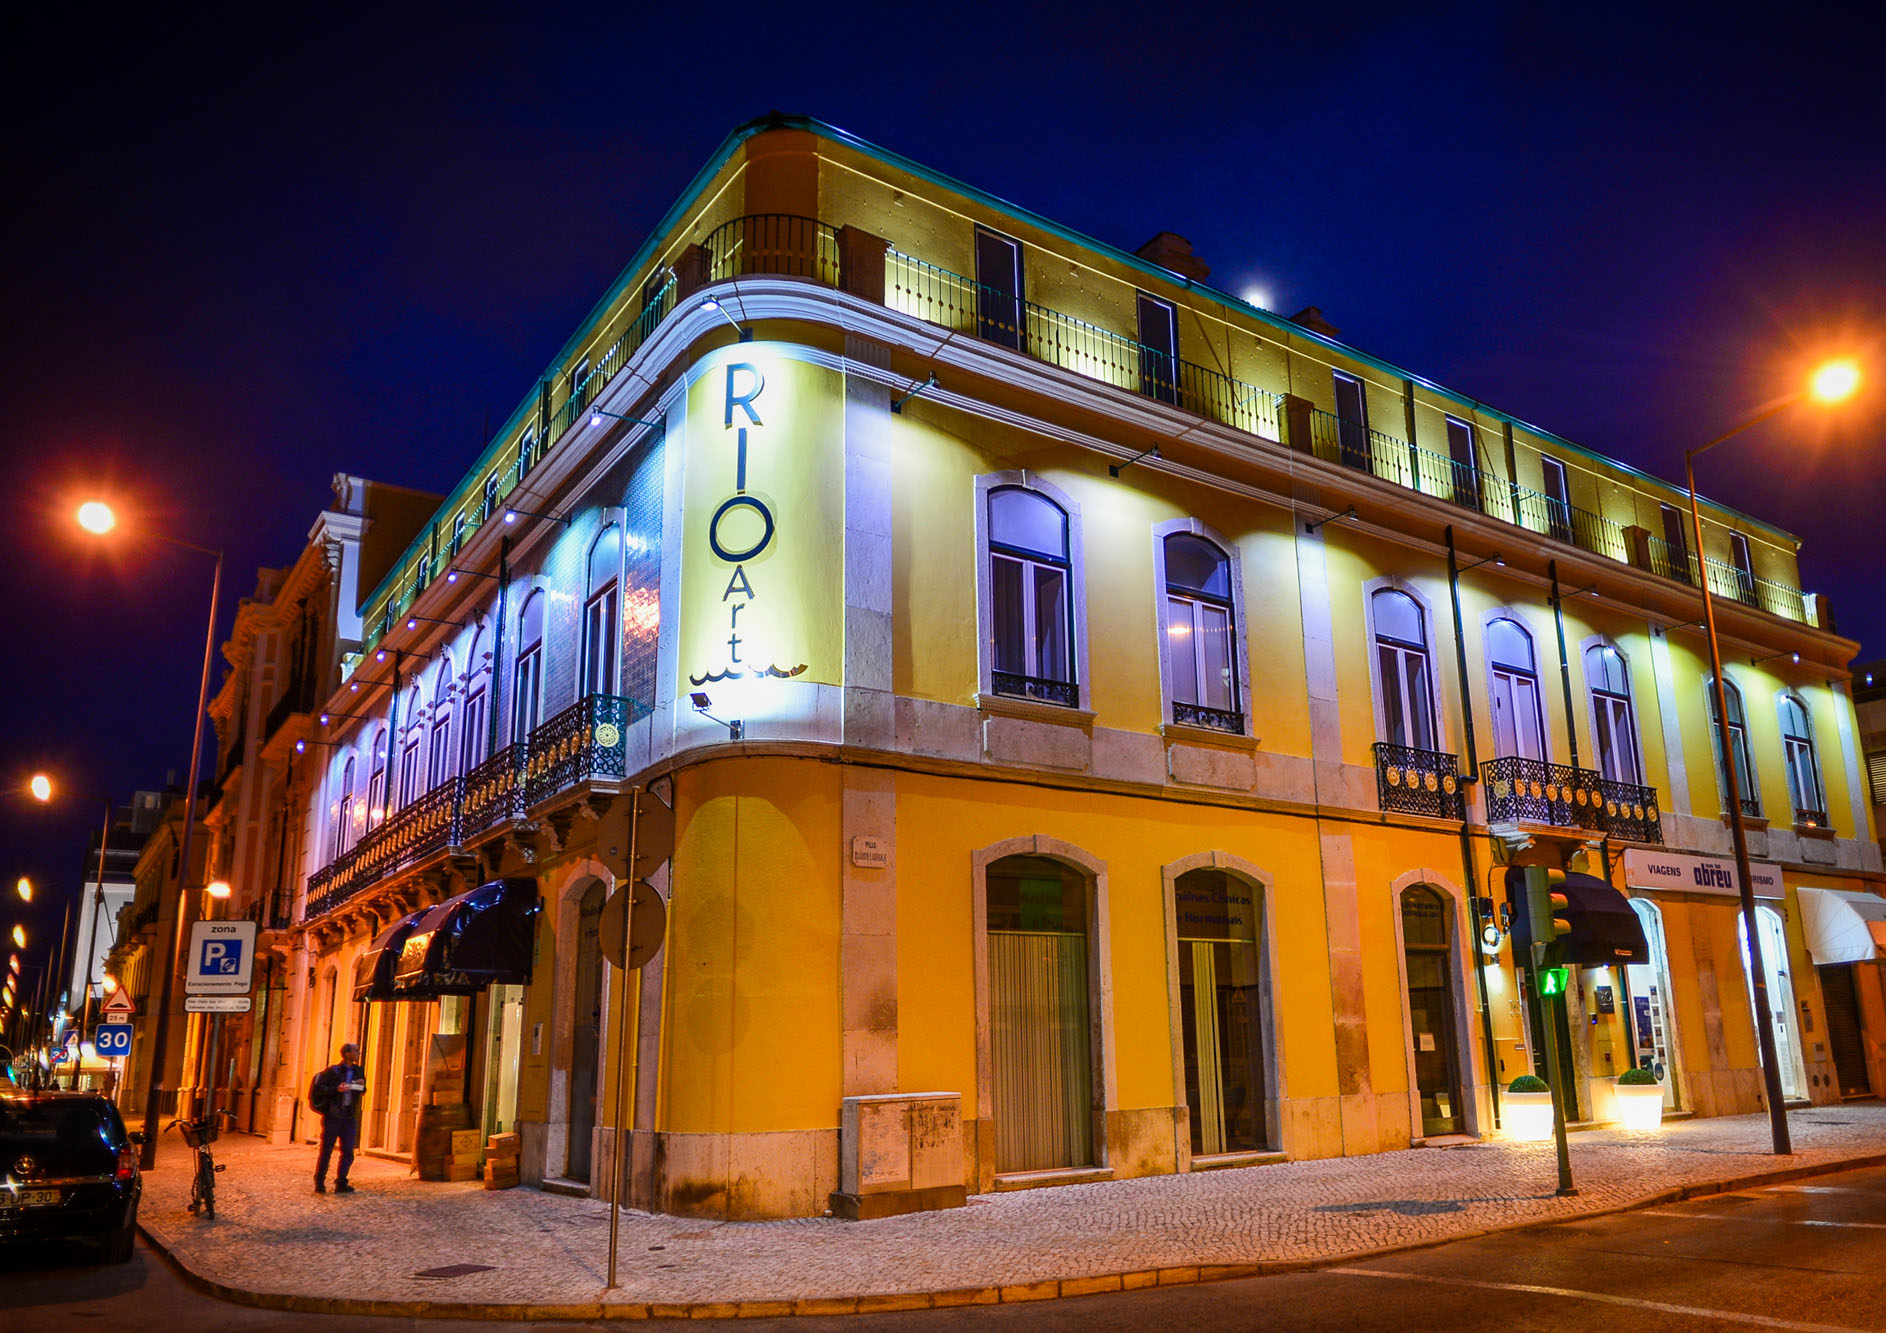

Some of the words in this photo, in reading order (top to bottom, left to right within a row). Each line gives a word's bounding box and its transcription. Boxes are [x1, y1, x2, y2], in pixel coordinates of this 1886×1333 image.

[709, 363, 775, 562] RIO
[722, 564, 755, 664] Art
[1647, 864, 1682, 877] VIAGENS
[1693, 862, 1733, 889] abreu
[1751, 874, 1774, 885] RISMO
[204, 943, 226, 967] P
[98, 1031, 128, 1048] 30
